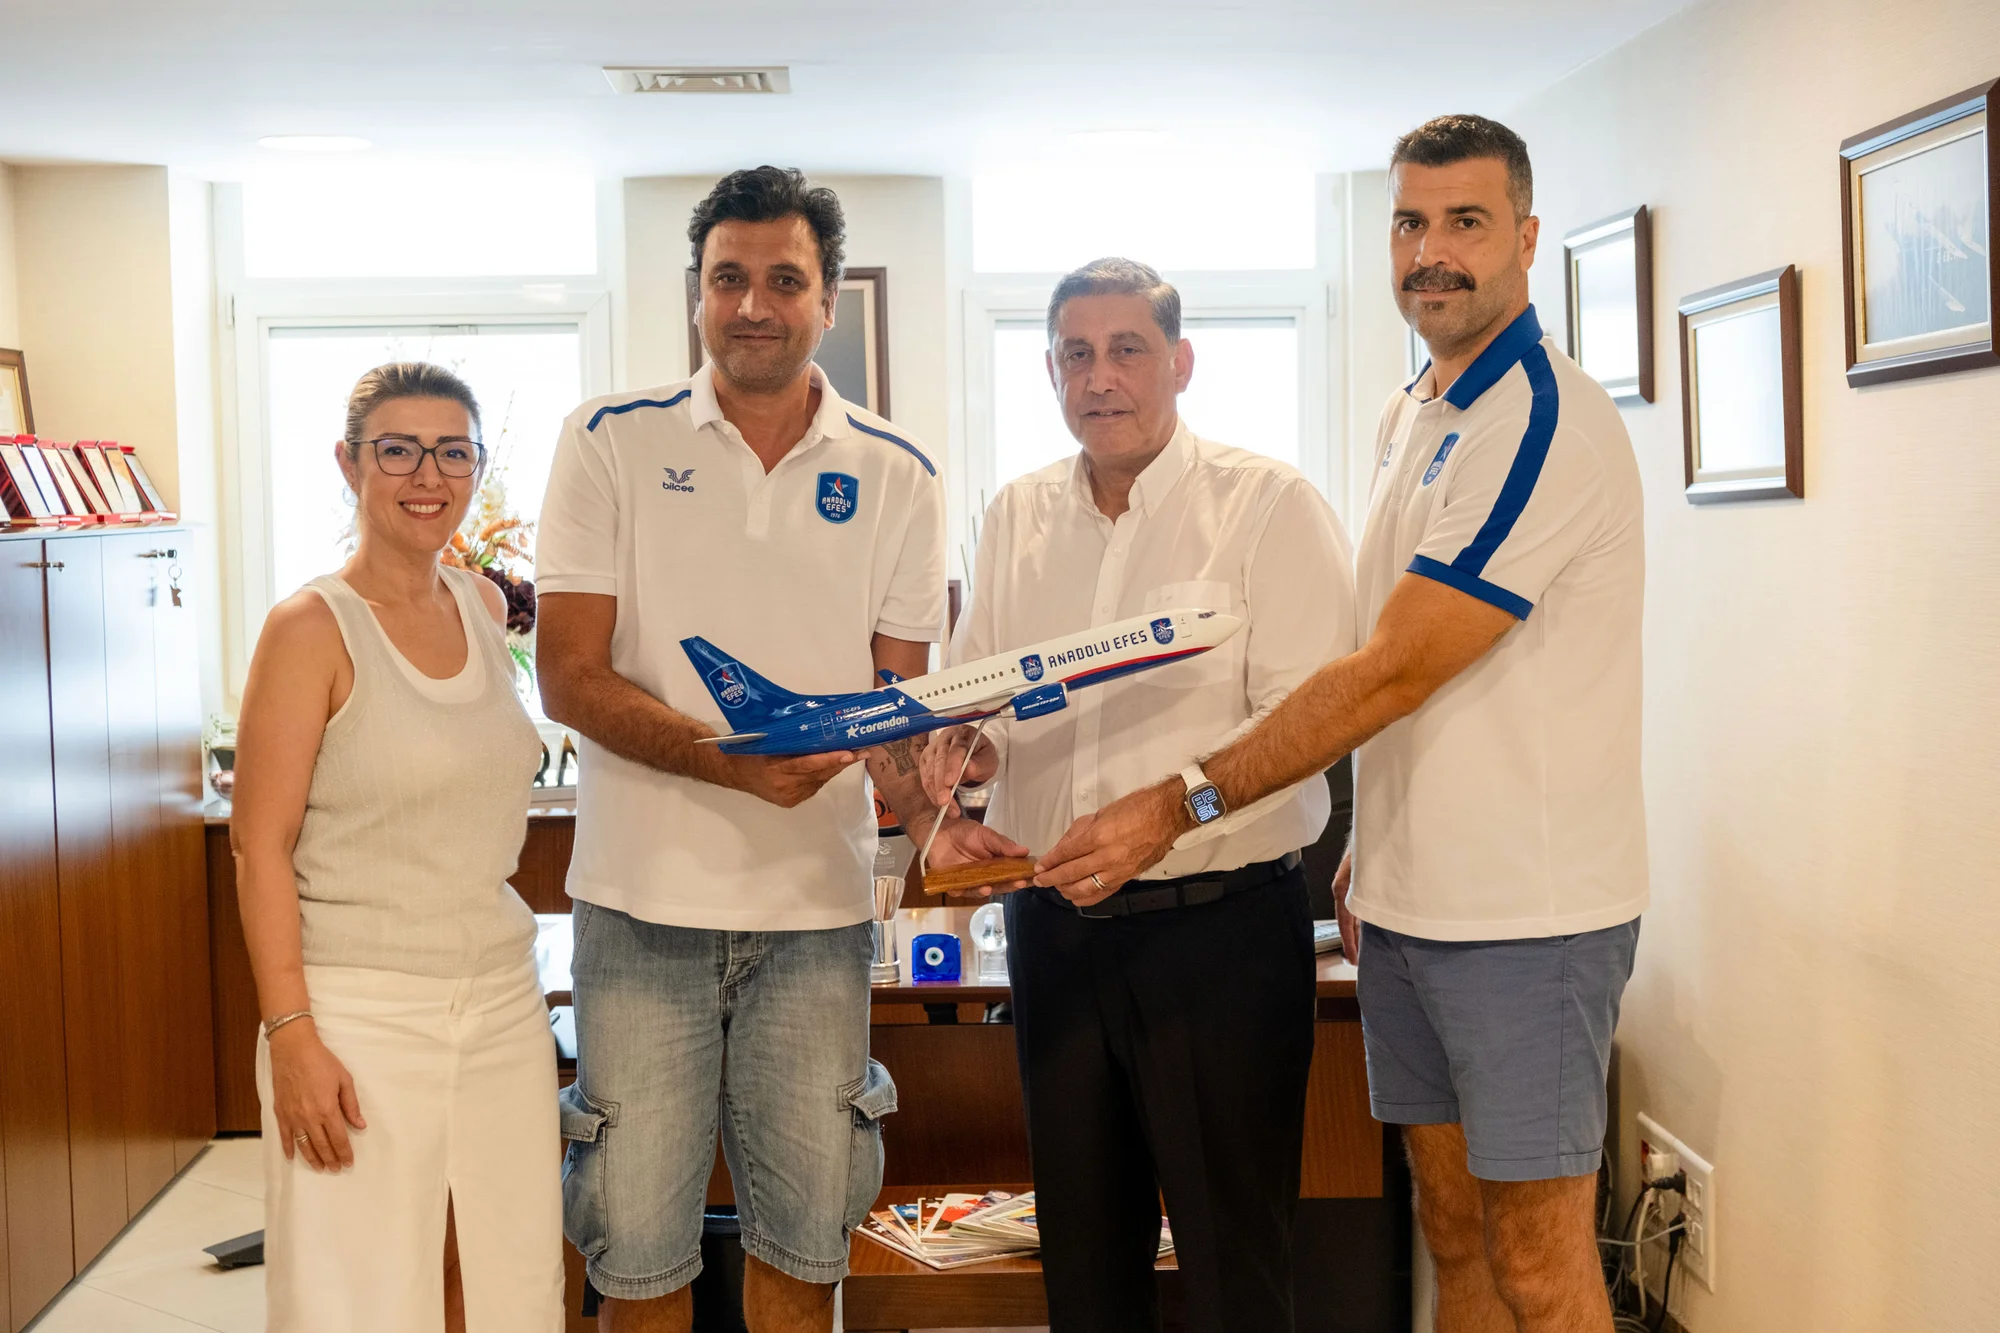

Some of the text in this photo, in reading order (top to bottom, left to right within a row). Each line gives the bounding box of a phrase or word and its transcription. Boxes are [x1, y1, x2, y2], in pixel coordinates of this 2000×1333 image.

[662, 481, 695, 493] bilcee
[821, 496, 852, 508] ANADOLU
[826, 503, 847, 513] EFES
[1048, 630, 1148, 668] ANADOLU EFES
[726, 689, 744, 702] EFES
[859, 715, 909, 735] corendon
